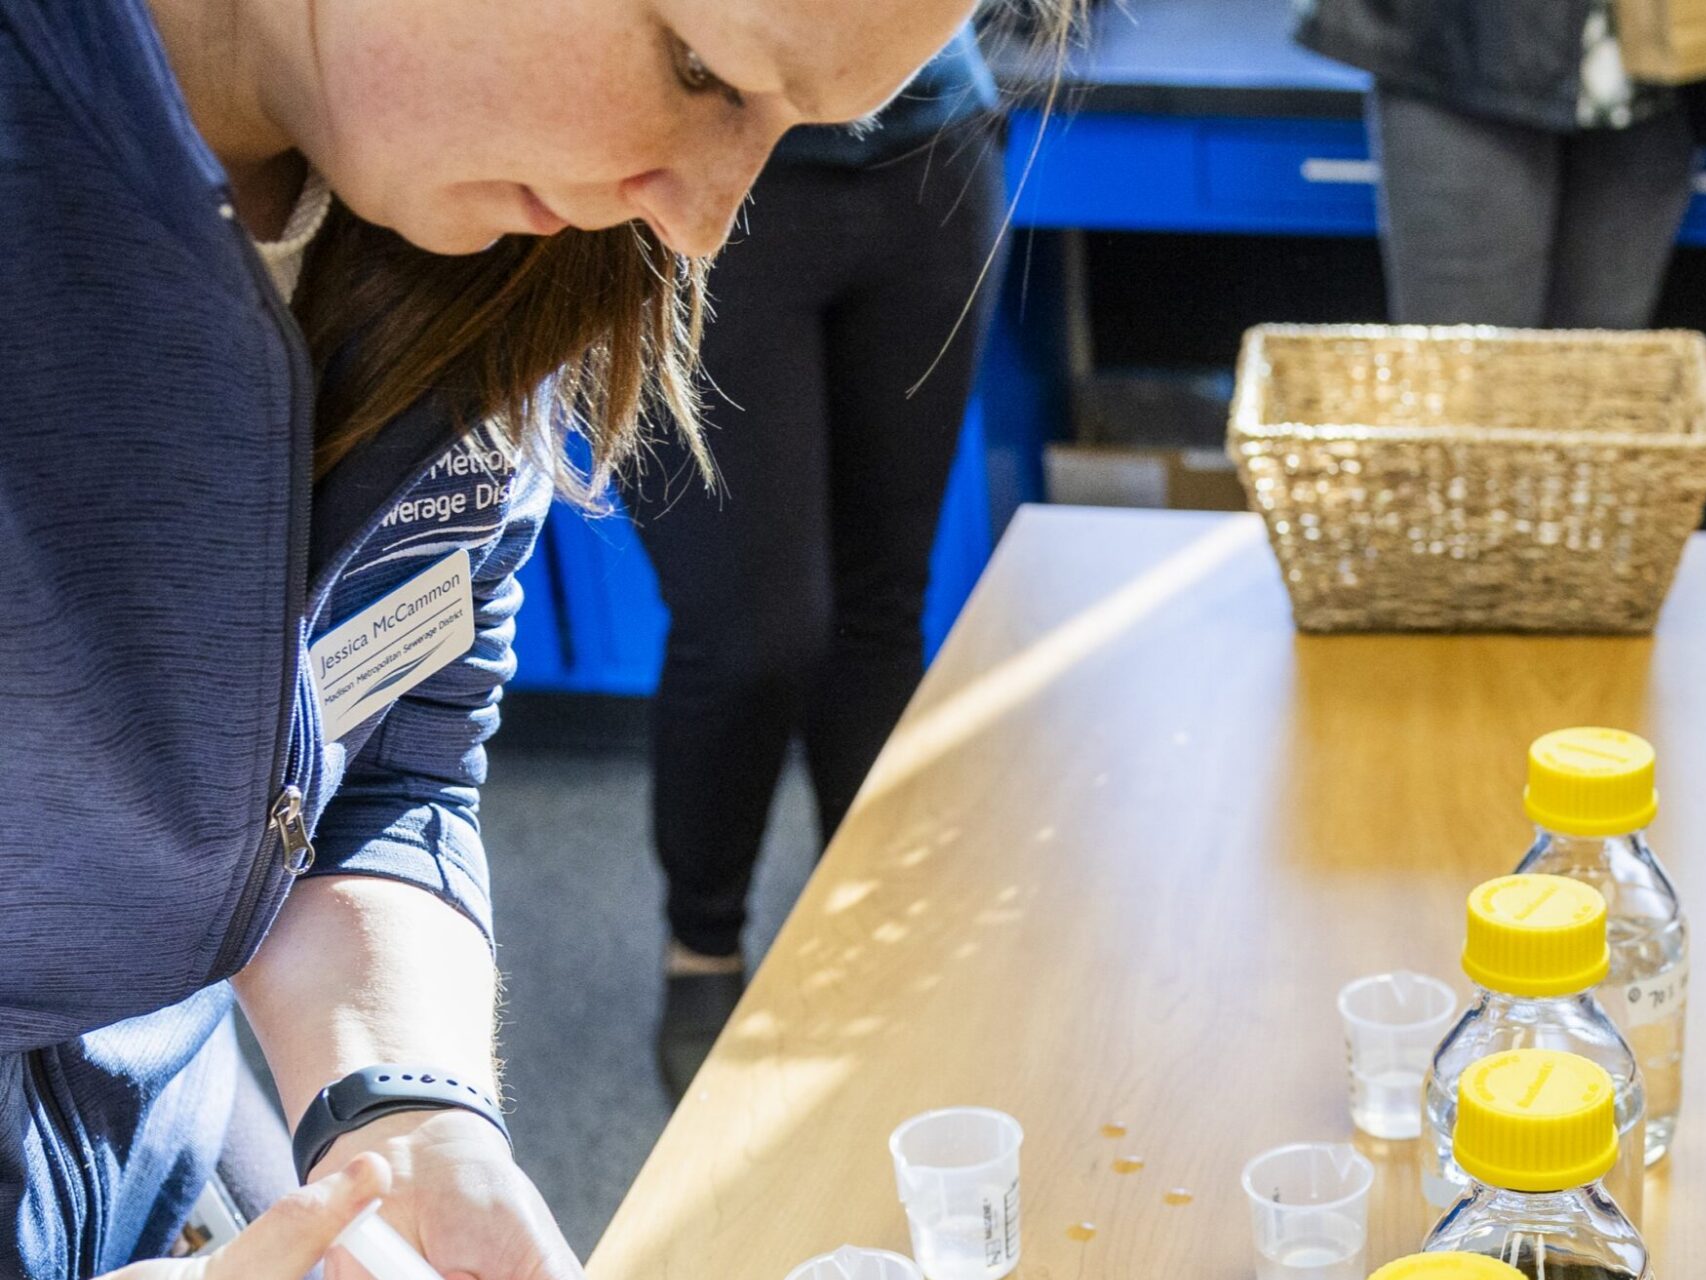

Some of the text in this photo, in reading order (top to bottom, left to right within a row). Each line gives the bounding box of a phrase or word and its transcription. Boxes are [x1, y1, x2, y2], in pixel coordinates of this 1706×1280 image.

[321, 574, 461, 679] Jessica McCammon
[324, 609, 464, 705] Madison Metropolitan Sewerage District
